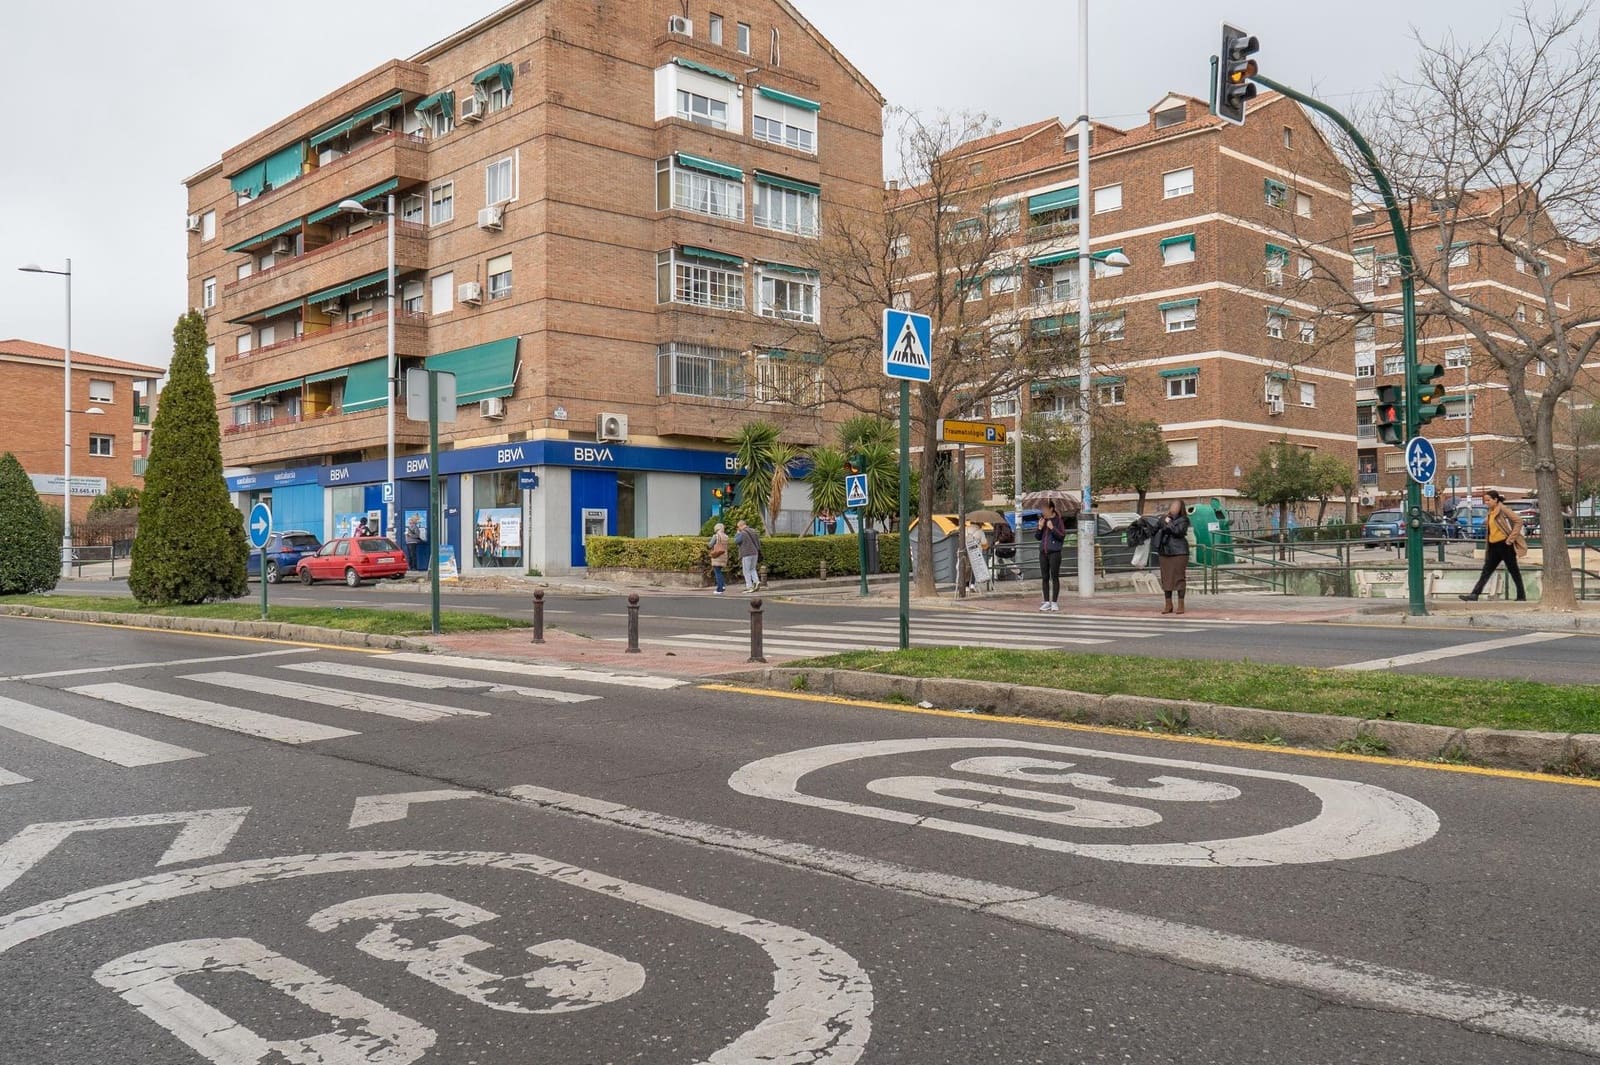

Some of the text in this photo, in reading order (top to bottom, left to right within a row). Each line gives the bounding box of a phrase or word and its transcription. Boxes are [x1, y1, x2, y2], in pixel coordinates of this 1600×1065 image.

[987, 428, 994, 440] P
[498, 446, 524, 463] BBVA
[574, 447, 614, 462] BBVA
[406, 457, 429, 473] BBVA
[330, 467, 349, 480] BBVA
